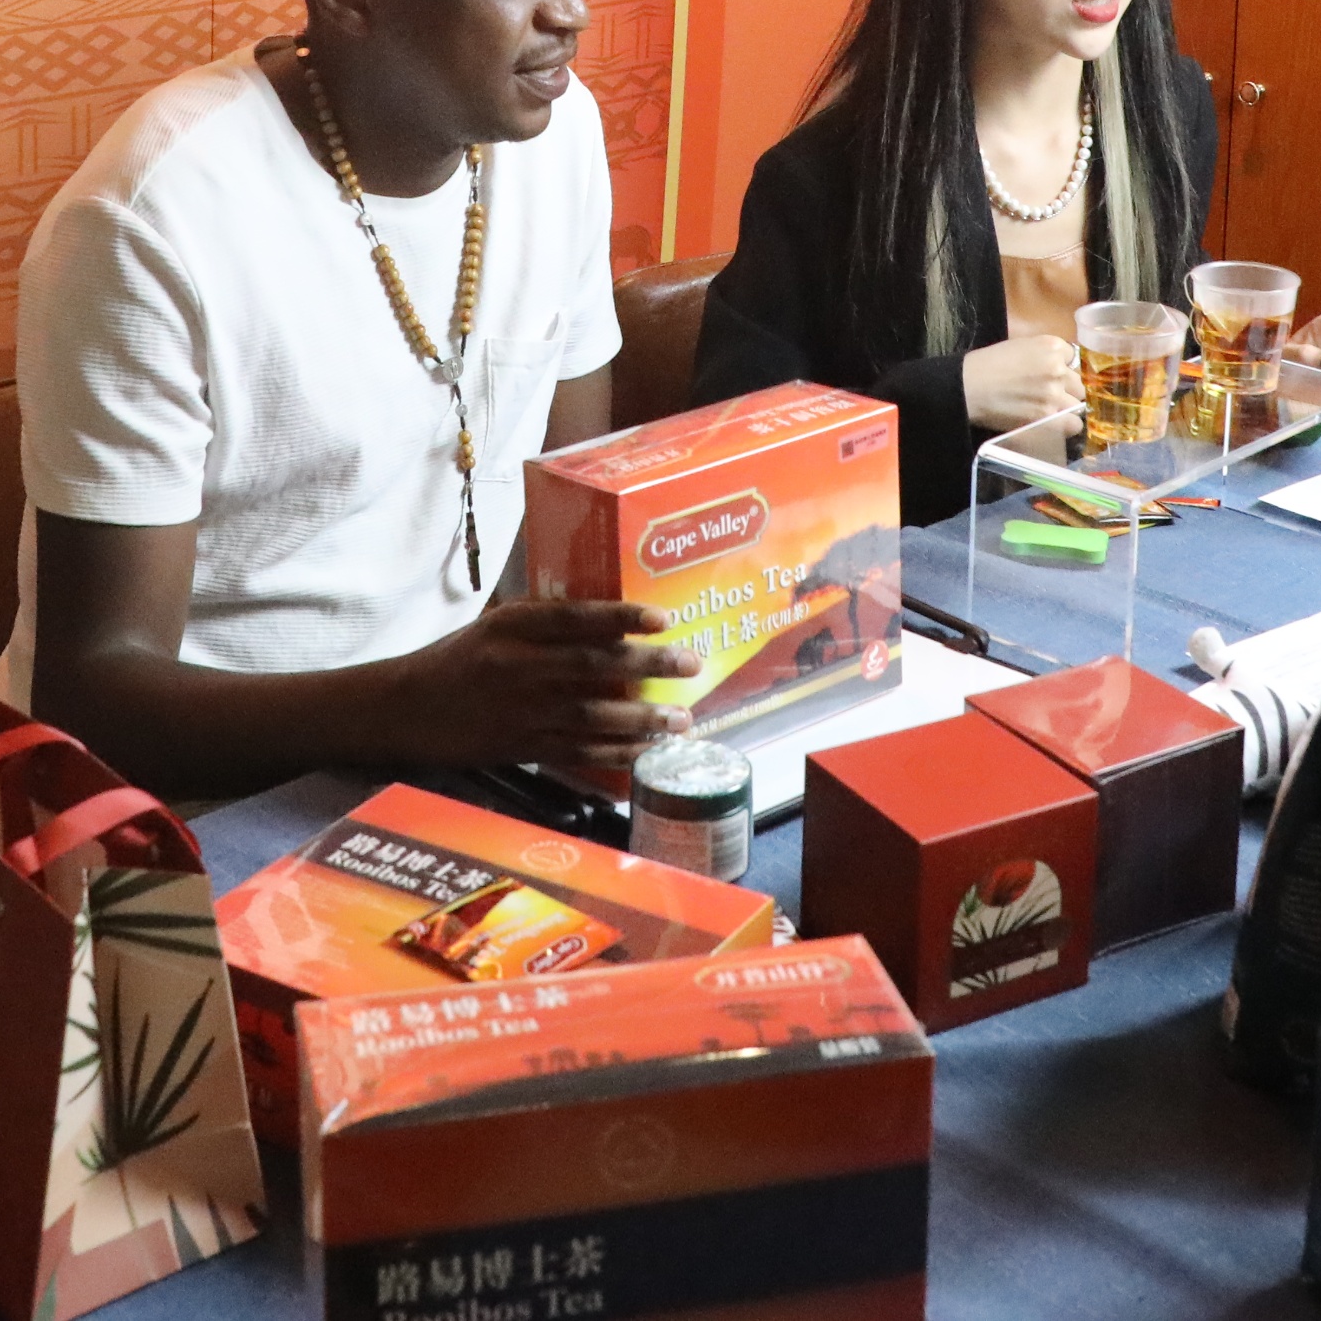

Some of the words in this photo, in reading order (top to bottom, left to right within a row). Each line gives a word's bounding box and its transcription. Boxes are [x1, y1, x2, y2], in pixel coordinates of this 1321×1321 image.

[649, 528, 698, 559] Cape
[699, 508, 752, 546] Valley
[667, 578, 756, 630] ooibos
[762, 562, 808, 594] Tea
[326, 848, 420, 892] Rooibos
[339, 831, 494, 892] 路易博士茶
[484, 1015, 540, 1041] Tea
[378, 1234, 608, 1306] 路易博士茶
[540, 1285, 605, 1315] Tea
